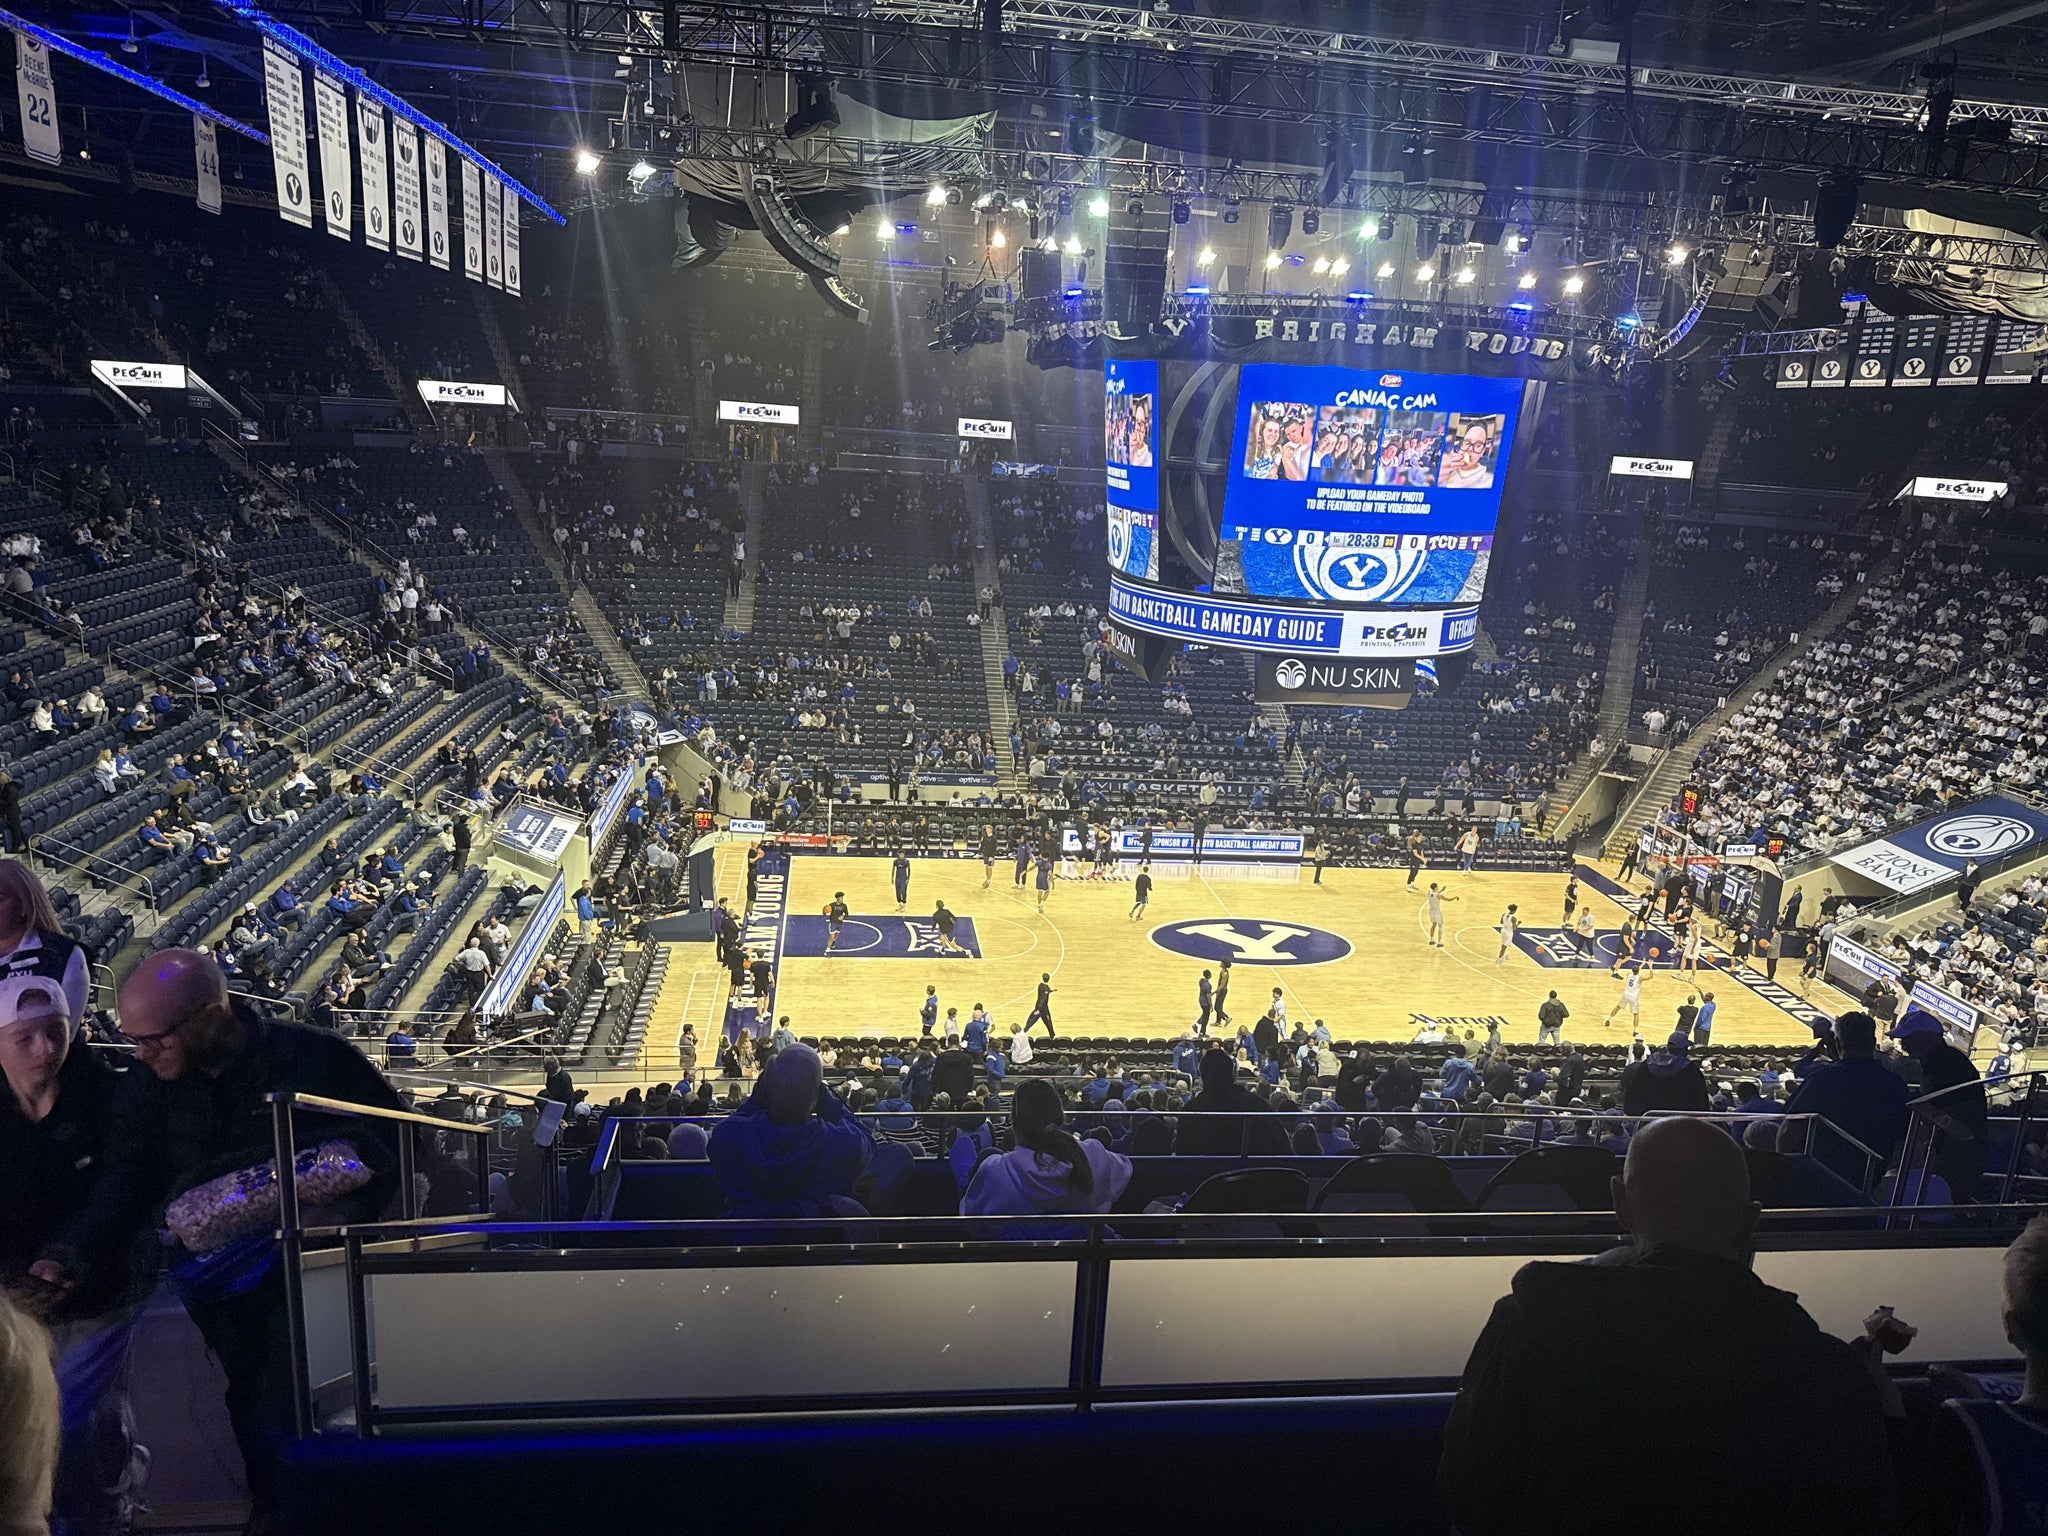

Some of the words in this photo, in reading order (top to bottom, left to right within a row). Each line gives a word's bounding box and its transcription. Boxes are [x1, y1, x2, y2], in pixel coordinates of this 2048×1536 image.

[27, 93, 51, 127] 22
[201, 150, 217, 177] 44
[1255, 318, 1437, 348] BRIGHAM
[1466, 331, 1566, 360] YOUNG
[1335, 389, 1400, 410] CANIAC
[1402, 393, 1438, 410] CAM
[1317, 488, 1345, 499] UPLOAD
[1347, 489, 1366, 500] YOUR
[1366, 490, 1400, 502] GAMEDAY
[1401, 491, 1425, 502] PHOTO
[1306, 499, 1316, 509] TO
[1316, 499, 1326, 510] BE
[1327, 500, 1361, 512] FEATURED
[1362, 502, 1373, 513] ON
[1374, 502, 1388, 513] THE
[1388, 503, 1431, 515] VIDEOBOARD
[1306, 532, 1315, 544] 0
[1347, 534, 1380, 548] 28:33
[1410, 537, 1419, 549] 0
[1429, 535, 1459, 550] TCU
[1132, 596, 1197, 628] BASKETBALL
[1202, 610, 1273, 638] GAMEDAY
[1277, 619, 1325, 642] GUIDE
[1311, 666, 1347, 688] NU
[1154, 838, 1181, 848] SPONSOR
[1181, 838, 1189, 848] OF
[1203, 839, 1214, 848] BYU
[1215, 839, 1251, 849] BASKETBALL
[1252, 840, 1280, 850] GAMEDAY
[1281, 841, 1298, 850] GUIDE
[1854, 857, 1917, 886] BANK
[1873, 850, 1937, 878] ZIONS
[747, 874, 785, 920] YOUNG
[1915, 984, 1939, 1006] BASKETBALL
